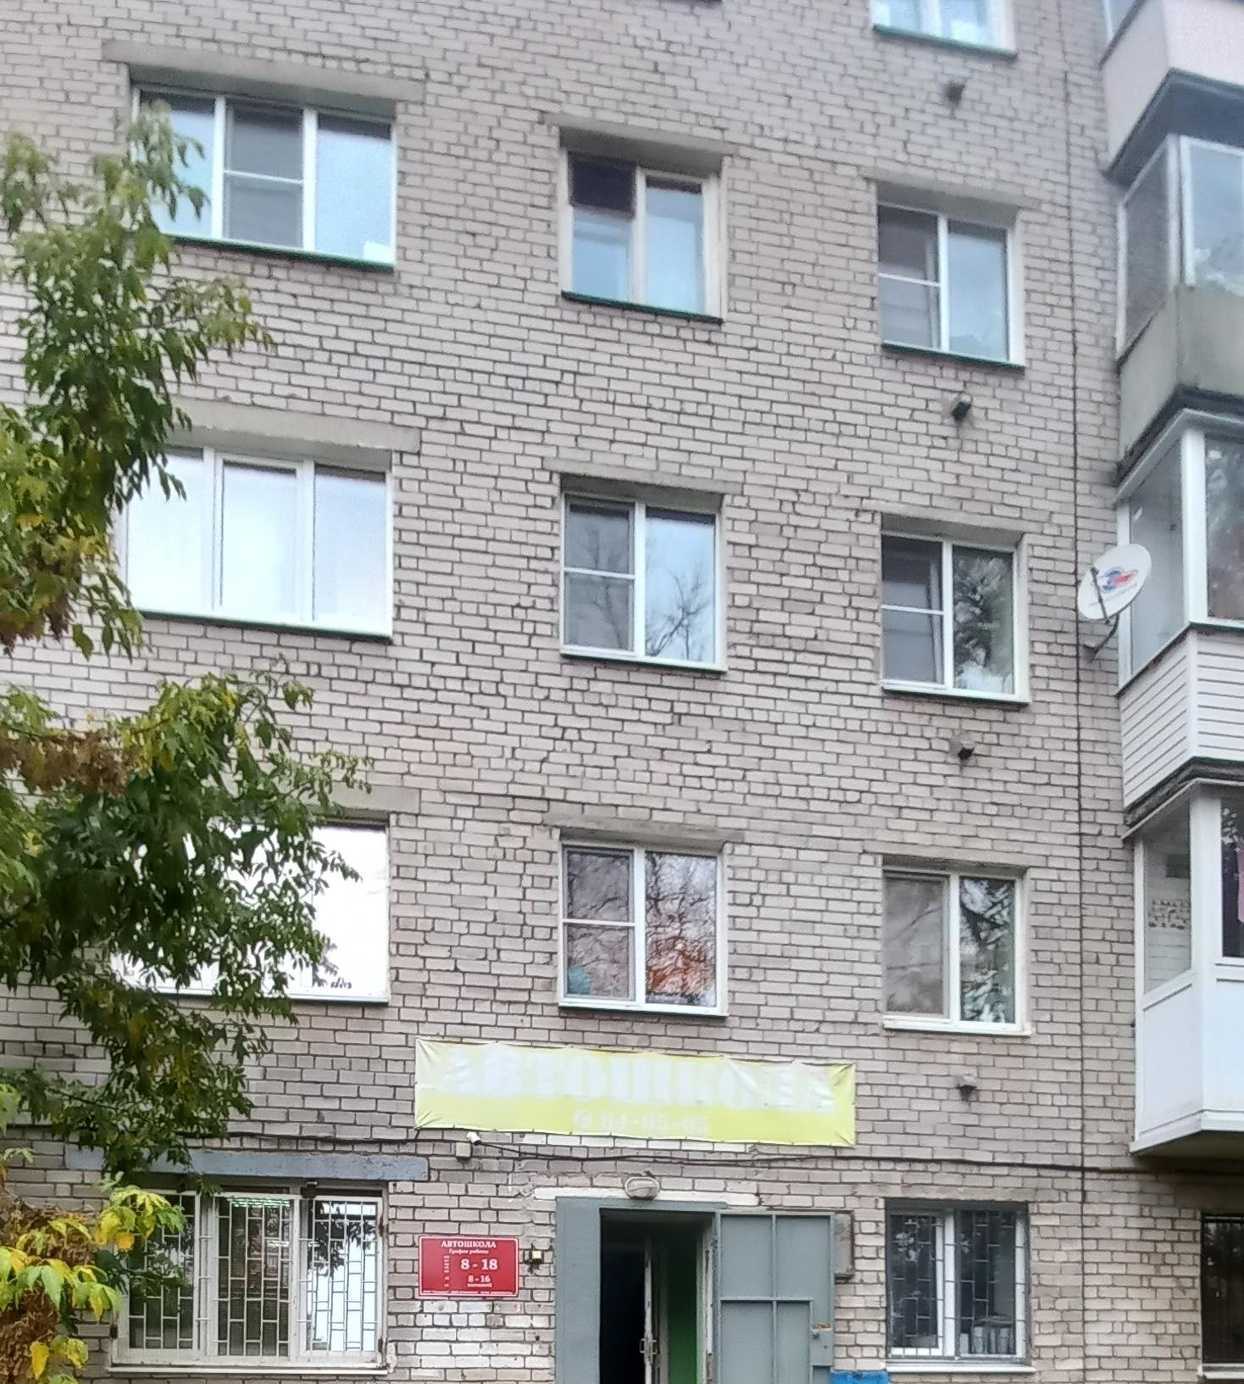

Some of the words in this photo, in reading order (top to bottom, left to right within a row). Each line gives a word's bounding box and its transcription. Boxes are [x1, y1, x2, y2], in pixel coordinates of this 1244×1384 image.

[441, 1240, 496, 1249] АВТОШКОЛА
[460, 1258, 470, 1270] 8
[481, 1258, 498, 1270] 18
[468, 1275, 474, 1283] 8
[480, 1275, 490, 1283] 16
